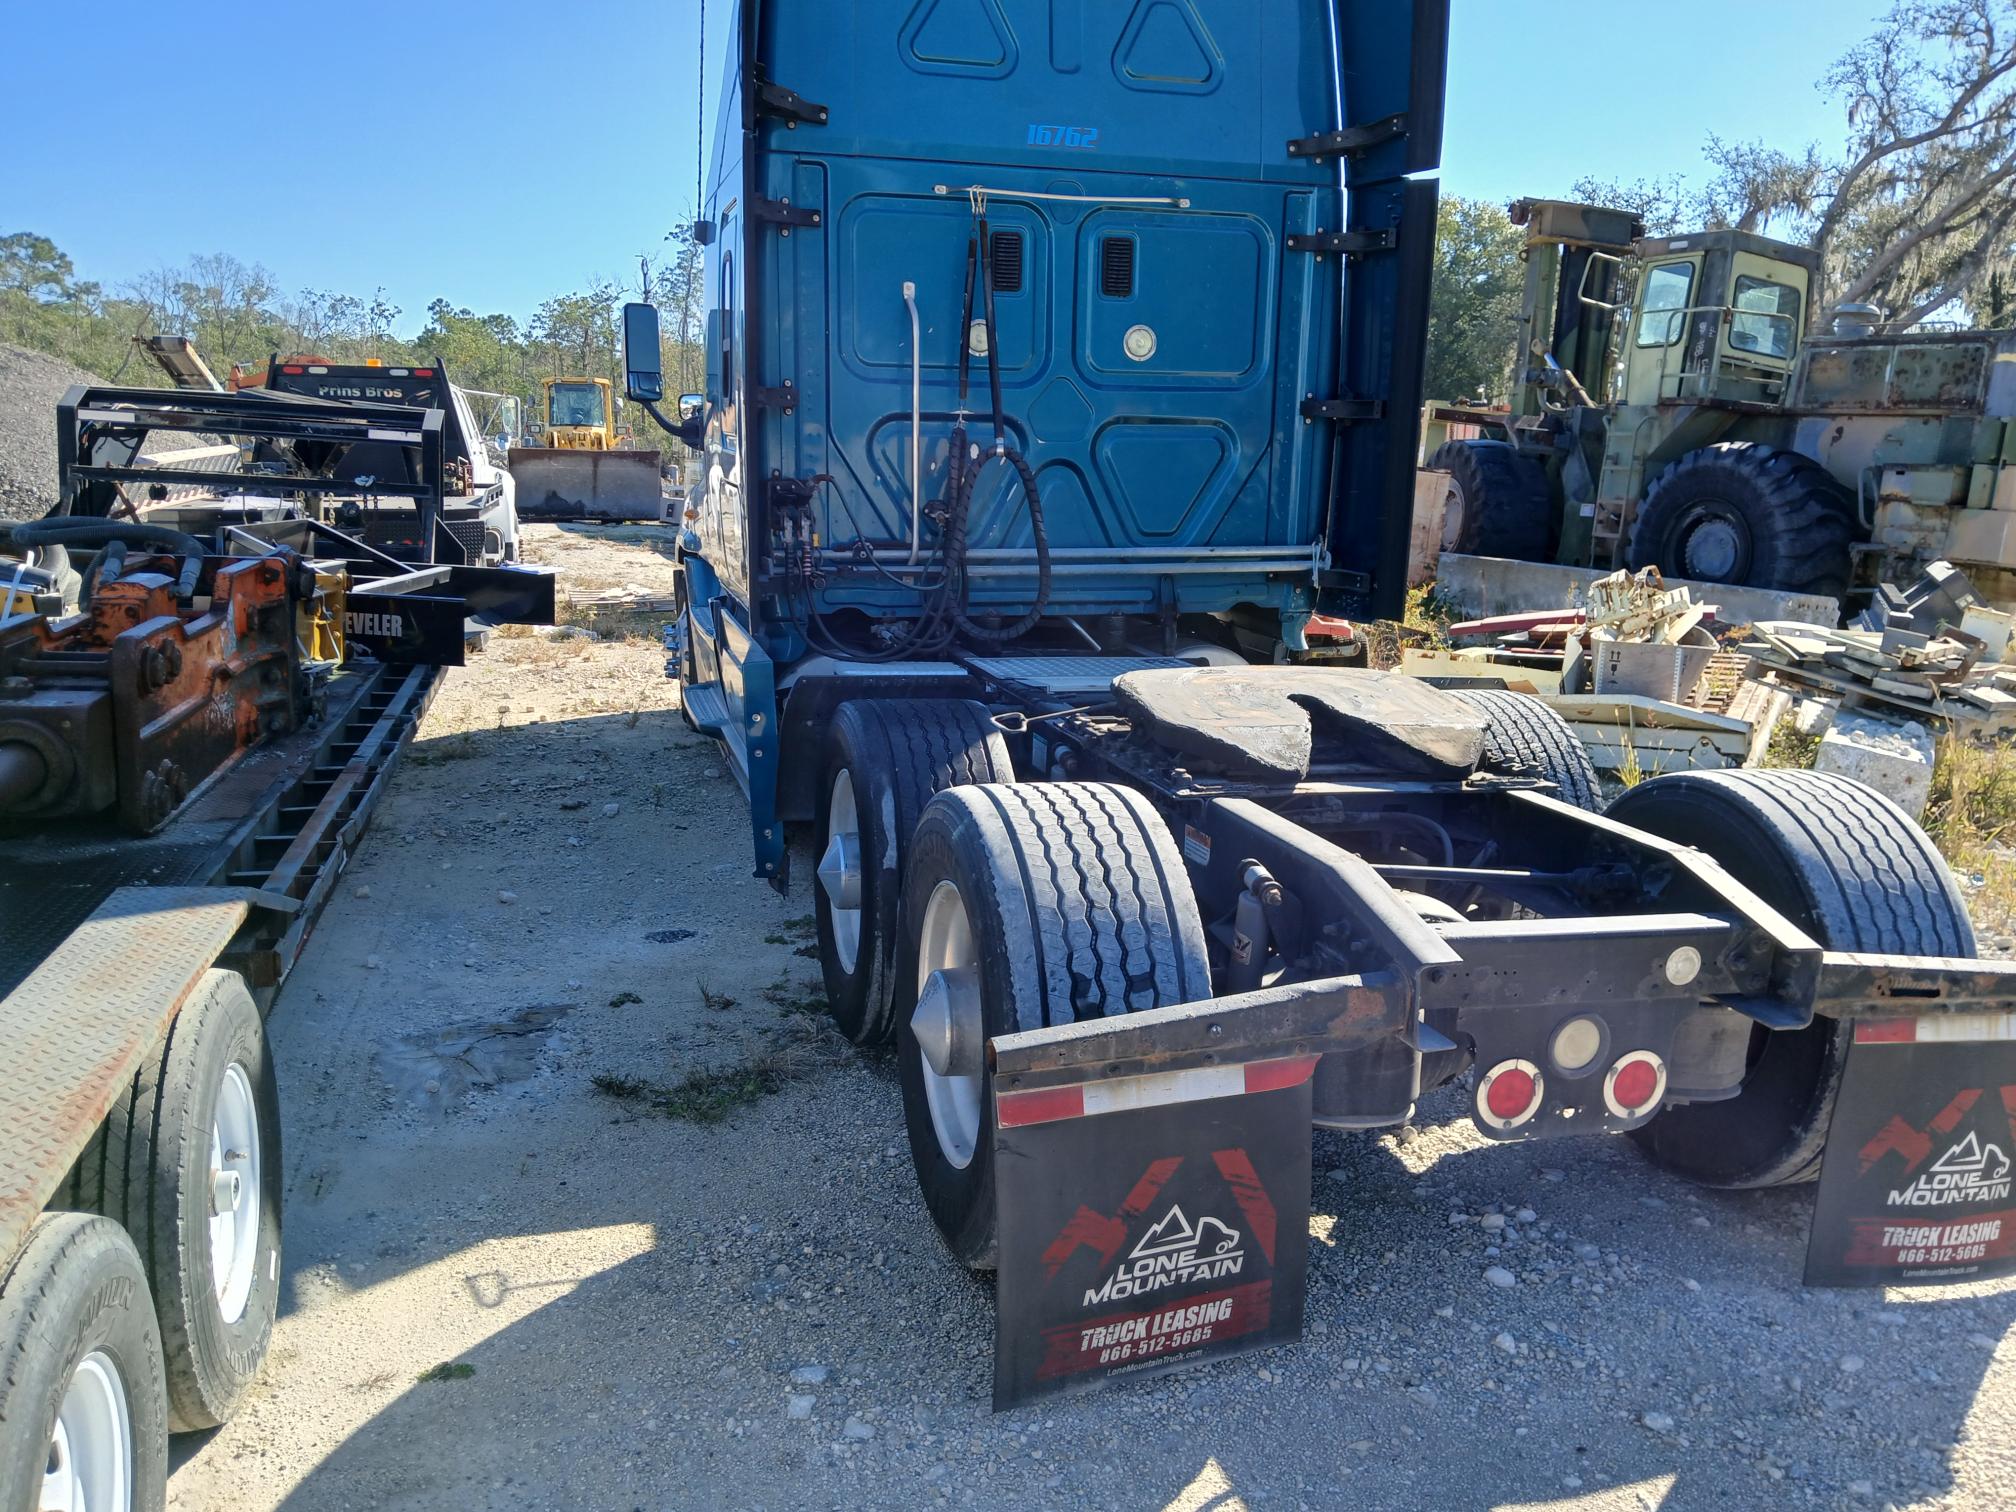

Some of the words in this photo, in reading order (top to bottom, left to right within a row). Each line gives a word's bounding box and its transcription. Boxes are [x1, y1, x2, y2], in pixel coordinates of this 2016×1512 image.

[1027, 124, 1098, 149] 16762
[318, 386, 361, 397] Prins
[365, 387, 403, 398] Bros
[345, 612, 402, 637] EVELER
[1886, 1181, 2011, 1206] MOUNTAIN
[1917, 1171, 1982, 1190] LONE
[1882, 1226, 1942, 1248] TRUCK
[1941, 1219, 2002, 1246] LEASING
[1116, 1249, 1198, 1282] LONE
[1897, 1244, 1987, 1263] 866-512-5685
[1083, 1256, 1244, 1307] MOUNTAIN
[1080, 1315, 1151, 1352] TRUCK
[1151, 1298, 1233, 1336] LEASING
[1100, 1325, 1213, 1364] 866-512-5685
[1106, 1349, 1203, 1377] LoneMountainTruck.com
